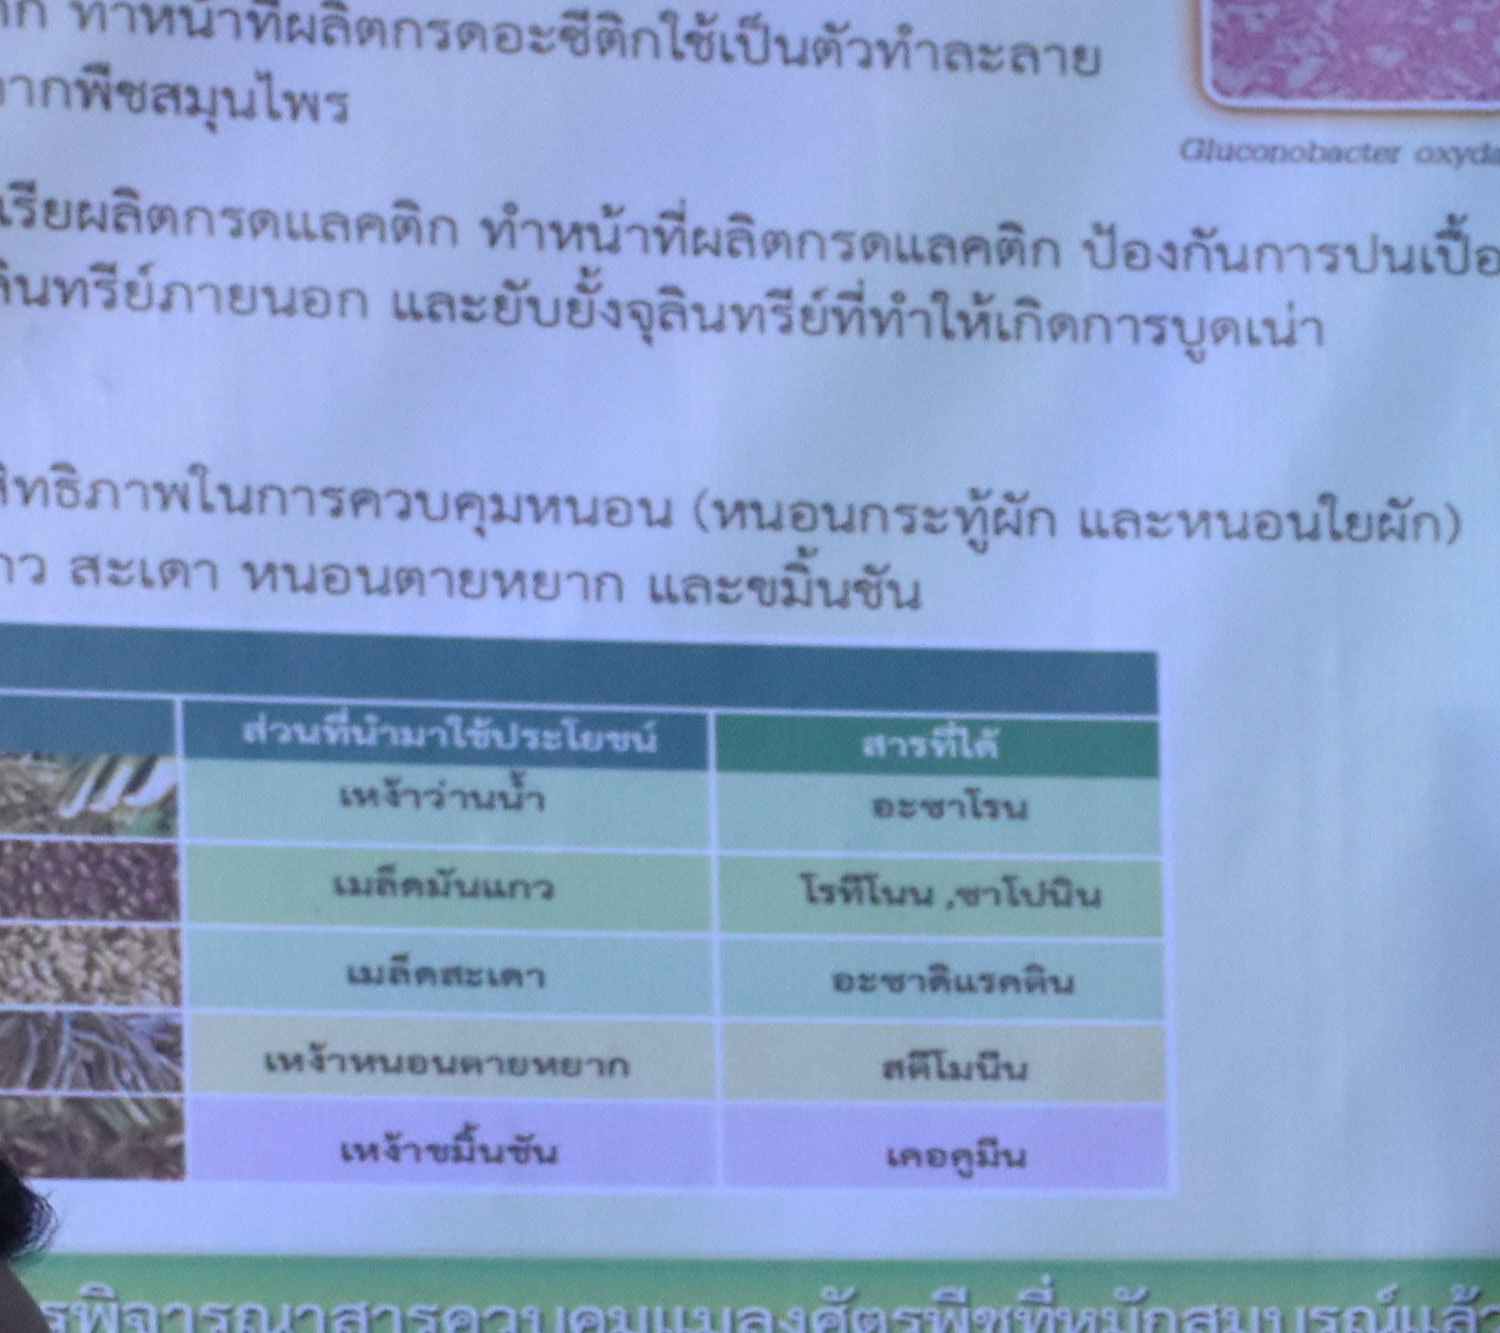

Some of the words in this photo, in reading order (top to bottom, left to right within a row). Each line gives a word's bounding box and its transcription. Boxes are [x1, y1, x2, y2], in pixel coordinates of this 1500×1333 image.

[479, 199, 1062, 275] ทำหน้าที่ผลิตกรดแลคติก
[68, 553, 219, 591] สะเดา
[239, 559, 625, 604] หนอนตายหยาก
[648, 545, 923, 612] และขมิ้นชัน
